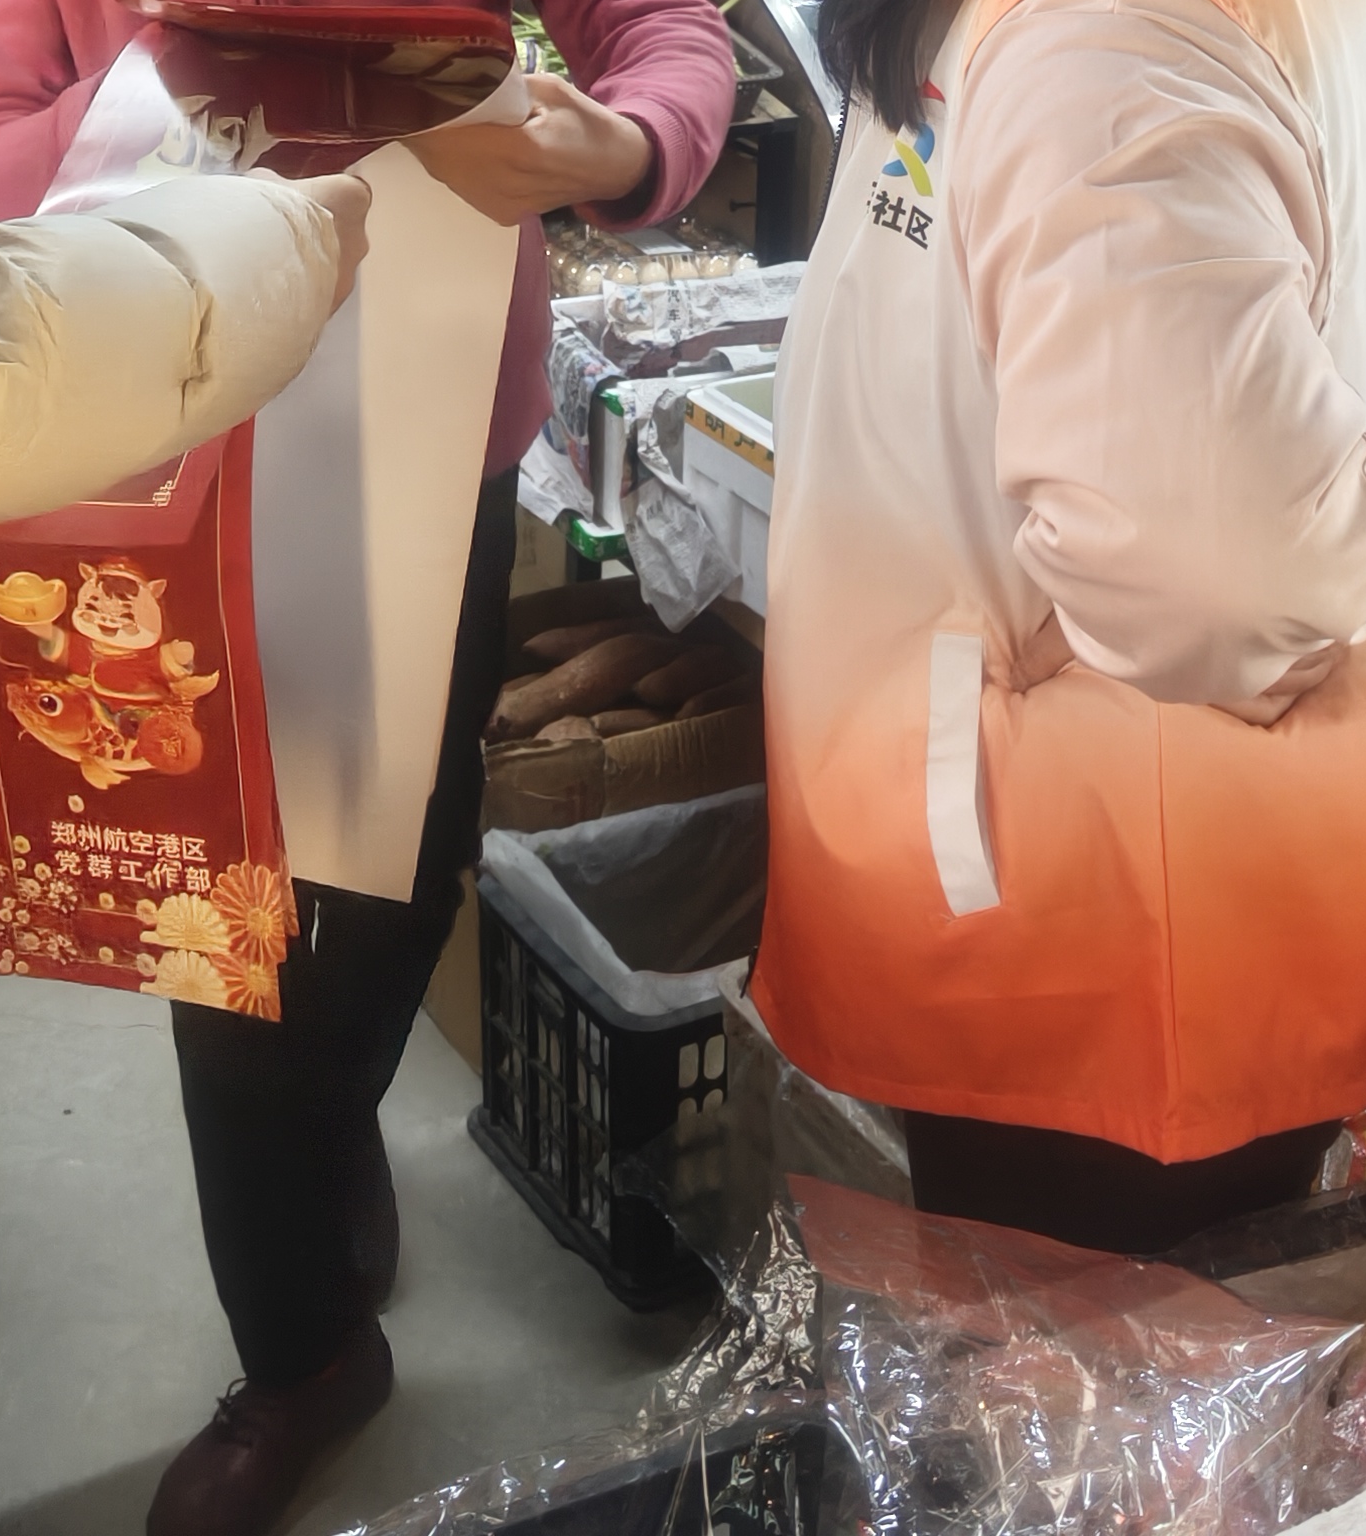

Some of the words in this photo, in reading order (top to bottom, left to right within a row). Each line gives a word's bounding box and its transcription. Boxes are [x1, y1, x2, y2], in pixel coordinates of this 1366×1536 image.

[871, 189, 934, 251] 社区
[50, 820, 207, 863] 郑州航空港区
[56, 850, 212, 894] 党群工作部
